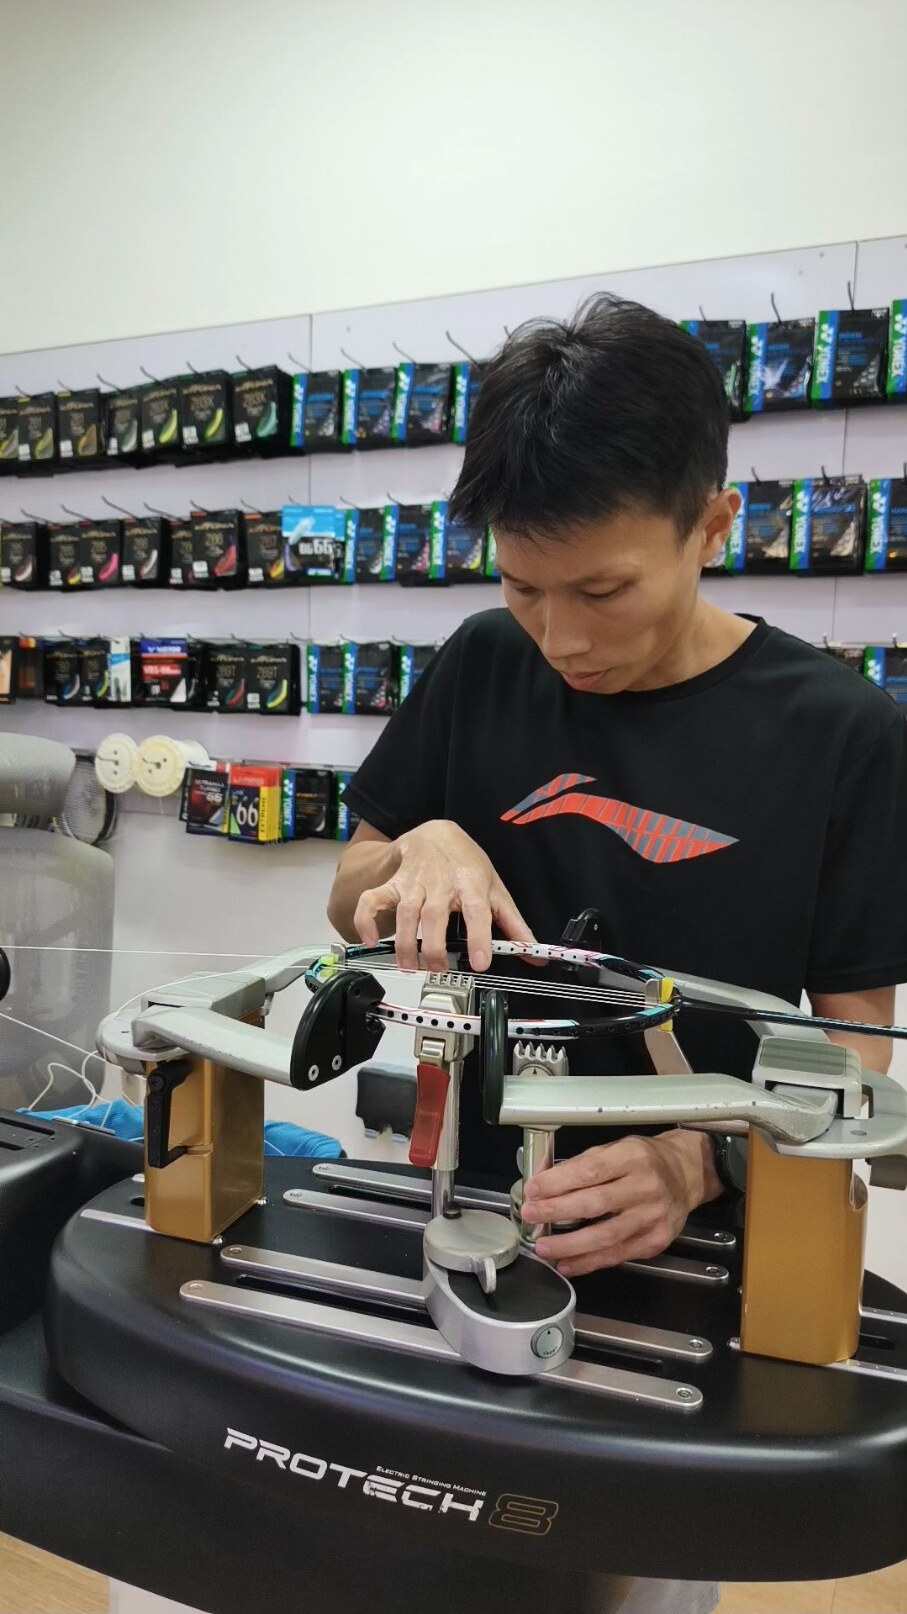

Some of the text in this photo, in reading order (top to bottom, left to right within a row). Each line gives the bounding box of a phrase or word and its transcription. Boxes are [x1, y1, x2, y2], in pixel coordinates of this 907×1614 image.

[236, 796, 259, 827] 66
[283, 797, 293, 826] YONEX
[224, 1427, 559, 1536] PROTECH 8
